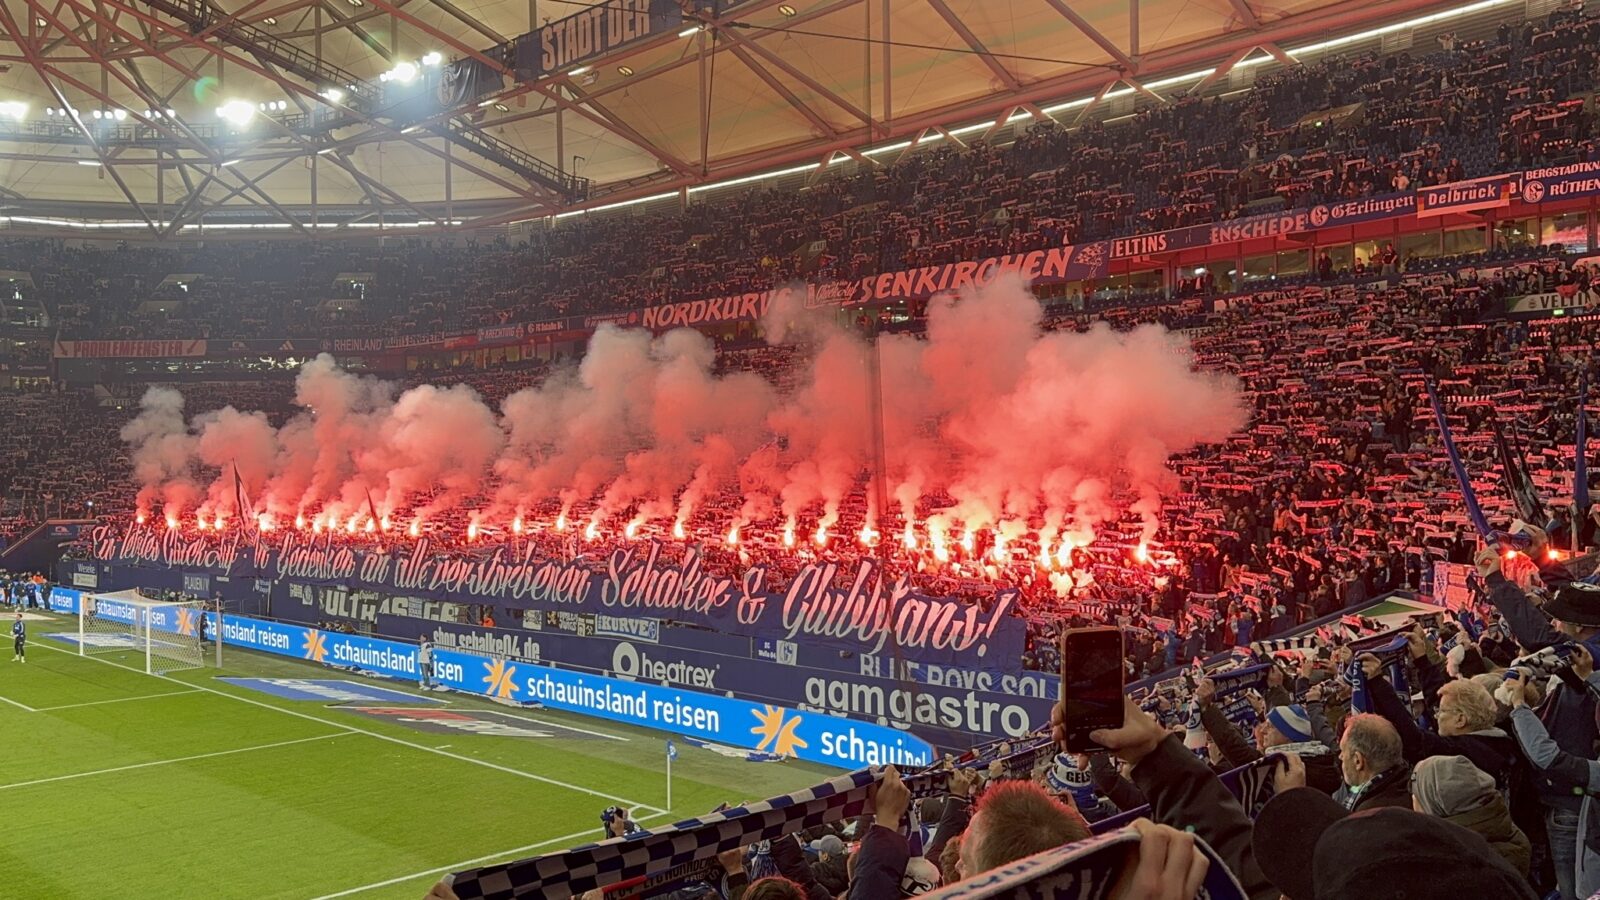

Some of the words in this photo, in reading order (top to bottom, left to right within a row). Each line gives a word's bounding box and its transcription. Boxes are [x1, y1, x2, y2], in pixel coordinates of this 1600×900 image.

[541, 7, 604, 71] STADT
[608, 0, 650, 47] DER
[1526, 161, 1600, 181] BERGSTADTKN
[1428, 184, 1497, 206] Delbrück
[1210, 213, 1308, 244] ENSCHEDE
[1540, 292, 1592, 309] VELTIN
[334, 338, 383, 351] RHEINLAND
[602, 538, 732, 616] Schalker
[736, 566, 768, 625] &
[97, 600, 136, 622] schauinslan
[258, 626, 290, 650] reisen
[601, 615, 650, 638] KURVE
[332, 639, 416, 674] schauinsland
[642, 657, 716, 689] heatrex
[527, 676, 648, 719] schauinsland
[653, 696, 720, 733] reisen
